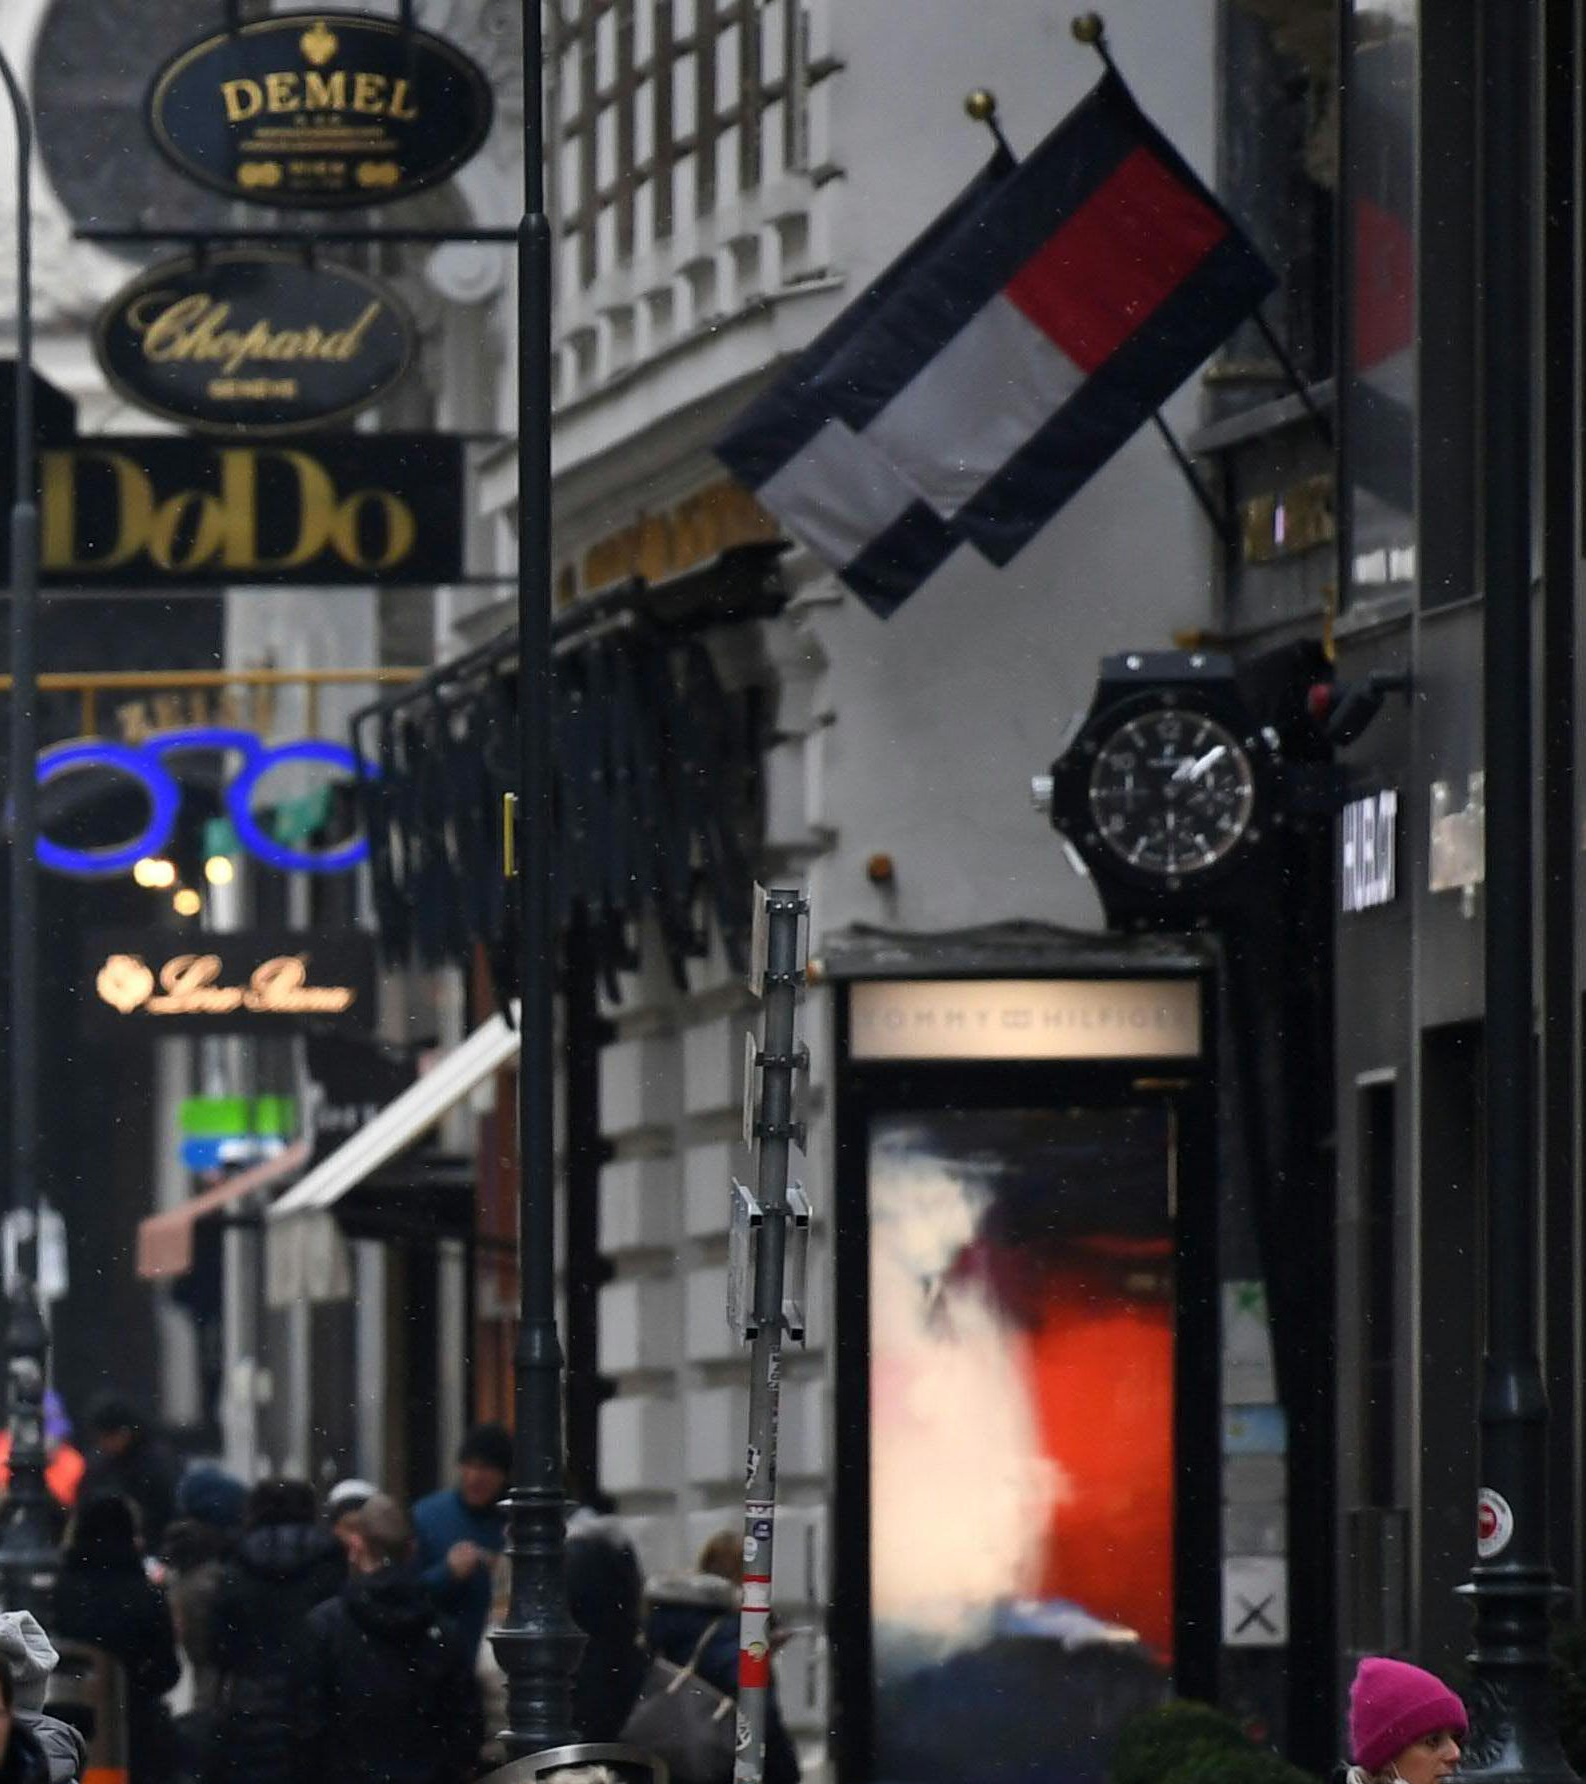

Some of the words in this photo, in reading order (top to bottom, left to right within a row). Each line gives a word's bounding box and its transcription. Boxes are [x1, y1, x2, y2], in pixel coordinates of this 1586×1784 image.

[220, 70, 419, 122] DEMEL
[127, 291, 380, 375] Chopard
[39, 448, 416, 571] DoDo
